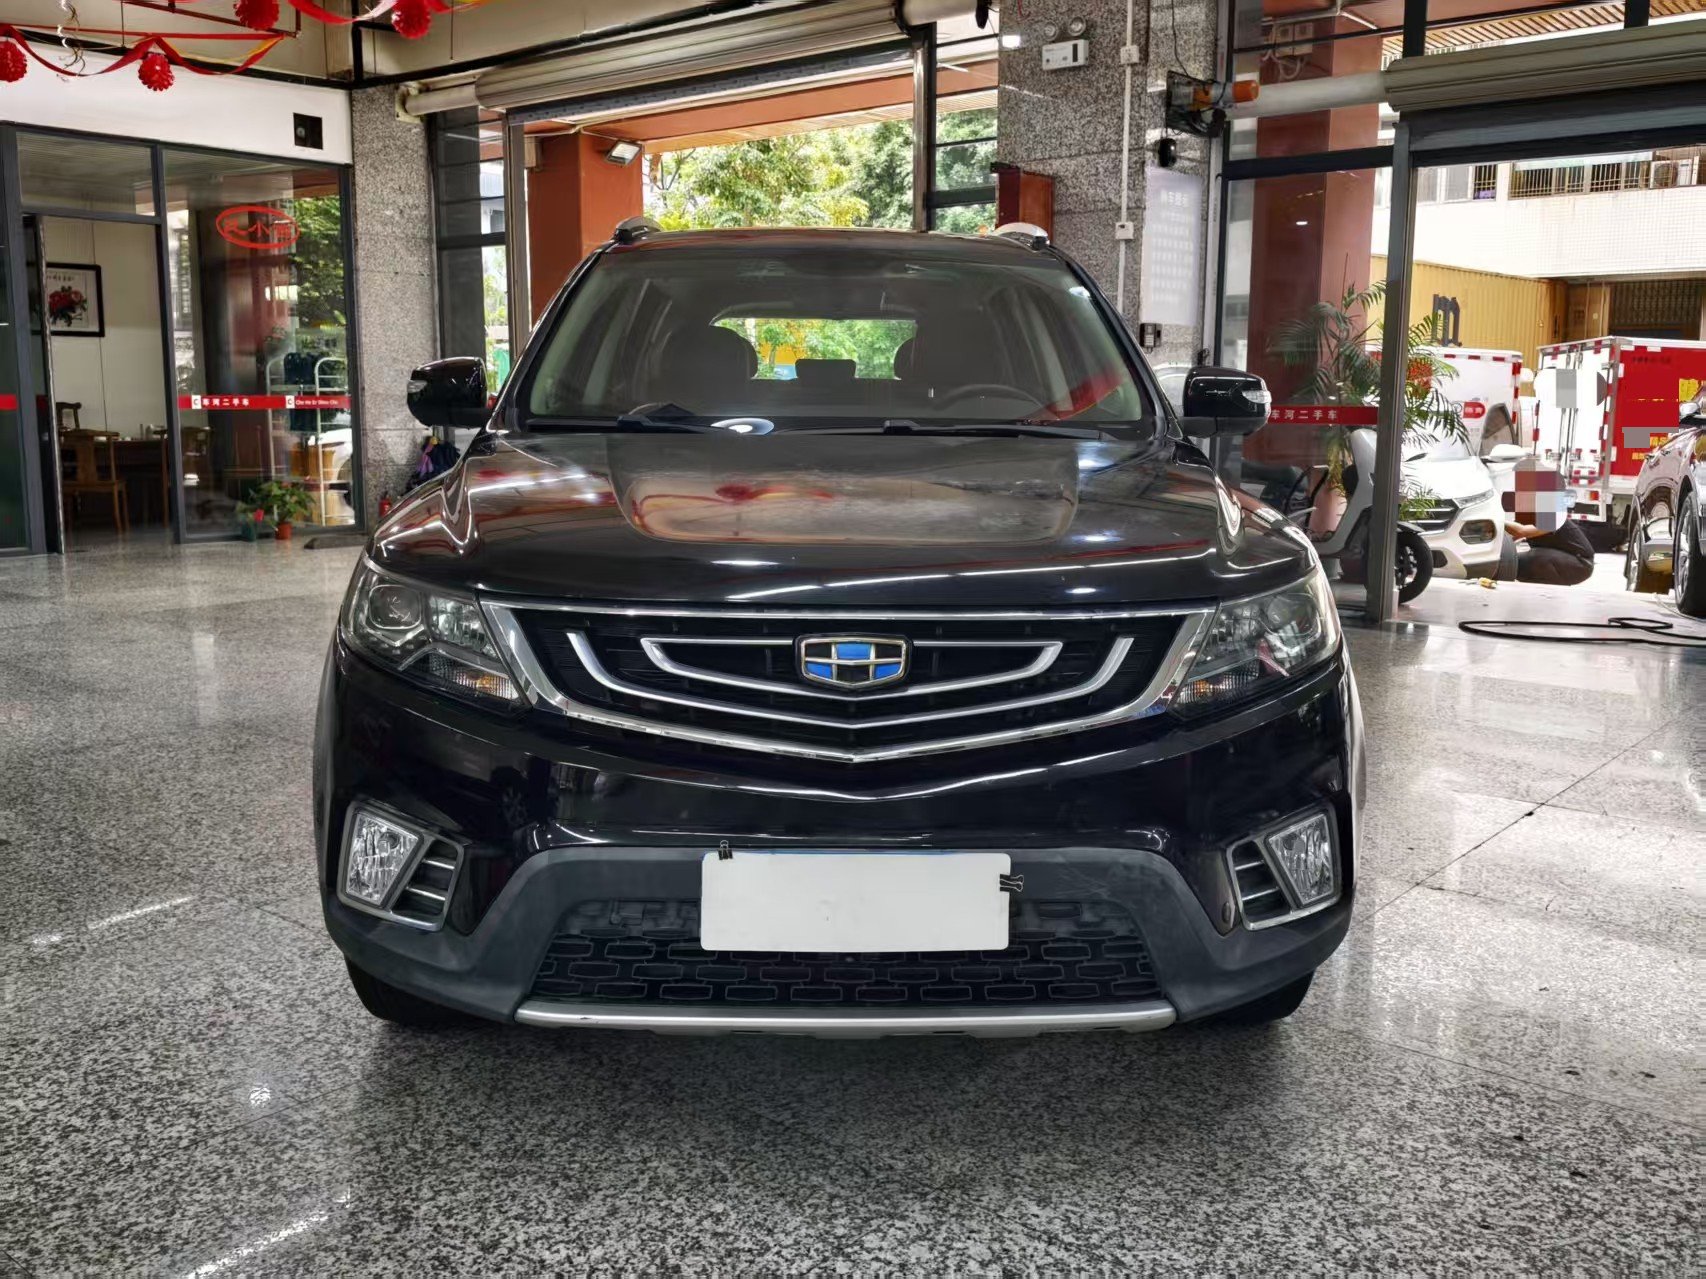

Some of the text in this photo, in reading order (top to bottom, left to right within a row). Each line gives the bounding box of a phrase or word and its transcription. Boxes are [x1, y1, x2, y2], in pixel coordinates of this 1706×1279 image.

[202, 398, 250, 406] 车河二手车
[1270, 409, 1338, 420] 车河二手车
